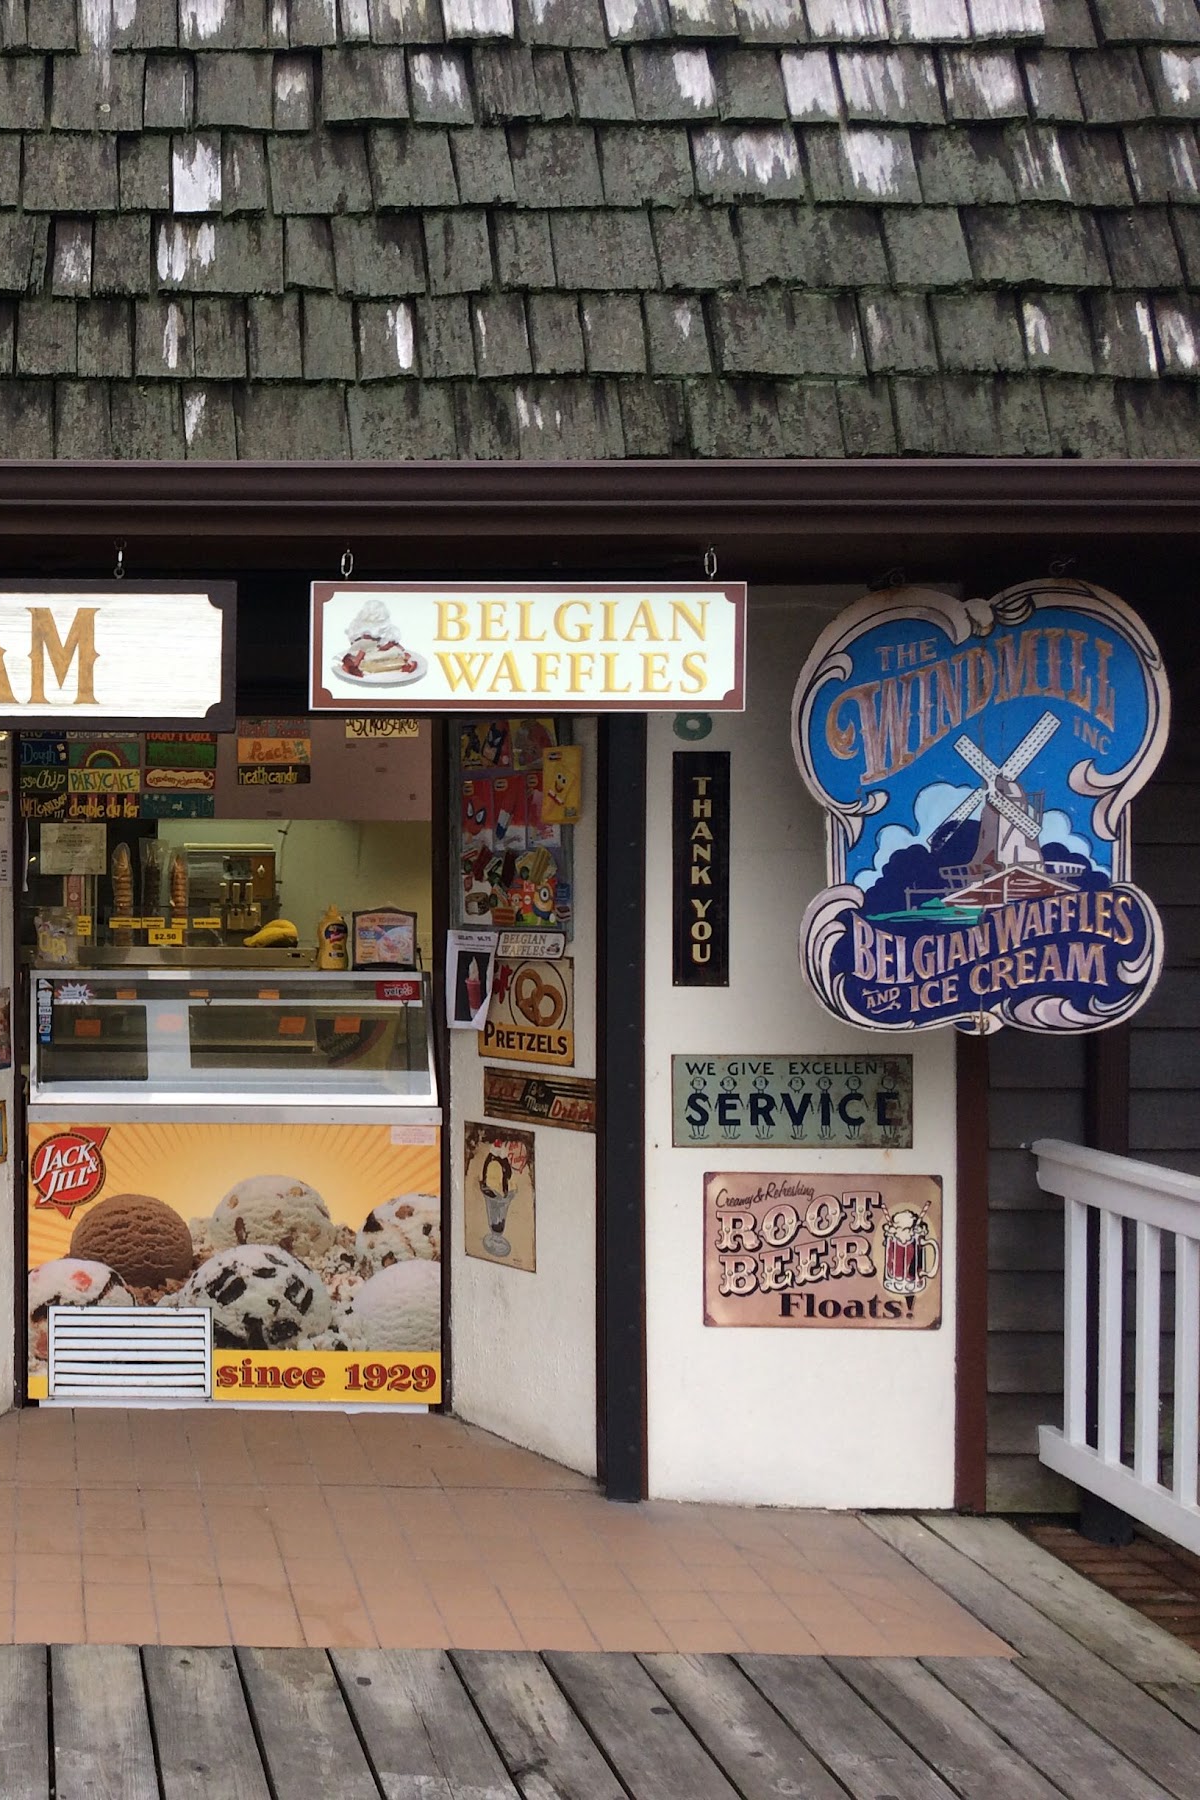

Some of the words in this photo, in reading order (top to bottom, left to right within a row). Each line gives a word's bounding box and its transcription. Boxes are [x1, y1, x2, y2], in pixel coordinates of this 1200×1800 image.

[432, 599, 710, 642] BELGIAN
[874, 636, 938, 672] THE
[434, 651, 709, 694] WAFFLES
[825, 627, 1115, 786] WINDMILL
[1073, 715, 1113, 756] INC
[21, 742, 57, 766] Dough
[69, 796, 105, 818] double
[691, 776, 714, 885] THANK
[154, 932, 177, 941] $2.50
[503, 933, 547, 945] BELGIAN
[691, 899, 713, 963] YOU
[851, 912, 990, 987] BELGIAN
[990, 890, 1135, 954] WAFFLES
[501, 944, 546, 956] WAFFLES
[384, 986, 404, 998] yelp
[862, 986, 902, 1014] AND
[909, 973, 959, 1013] ICE
[968, 943, 1109, 994] CREAM
[484, 1020, 568, 1056] PRETZELS
[685, 1062, 716, 1077] WE
[727, 1061, 775, 1077] GIVE
[685, 1092, 902, 1127] SERVICE
[33, 1141, 99, 1185] JACK
[85, 1156, 100, 1174] &
[39, 1164, 90, 1204] JILL
[716, 1187, 754, 1210] Creamy
[764, 1179, 816, 1202] Refreshing
[715, 1190, 883, 1254] ROOT
[717, 1235, 877, 1298] BEER
[778, 1292, 916, 1320] Floats!
[216, 1358, 326, 1389] since
[344, 1362, 437, 1391] 1929
